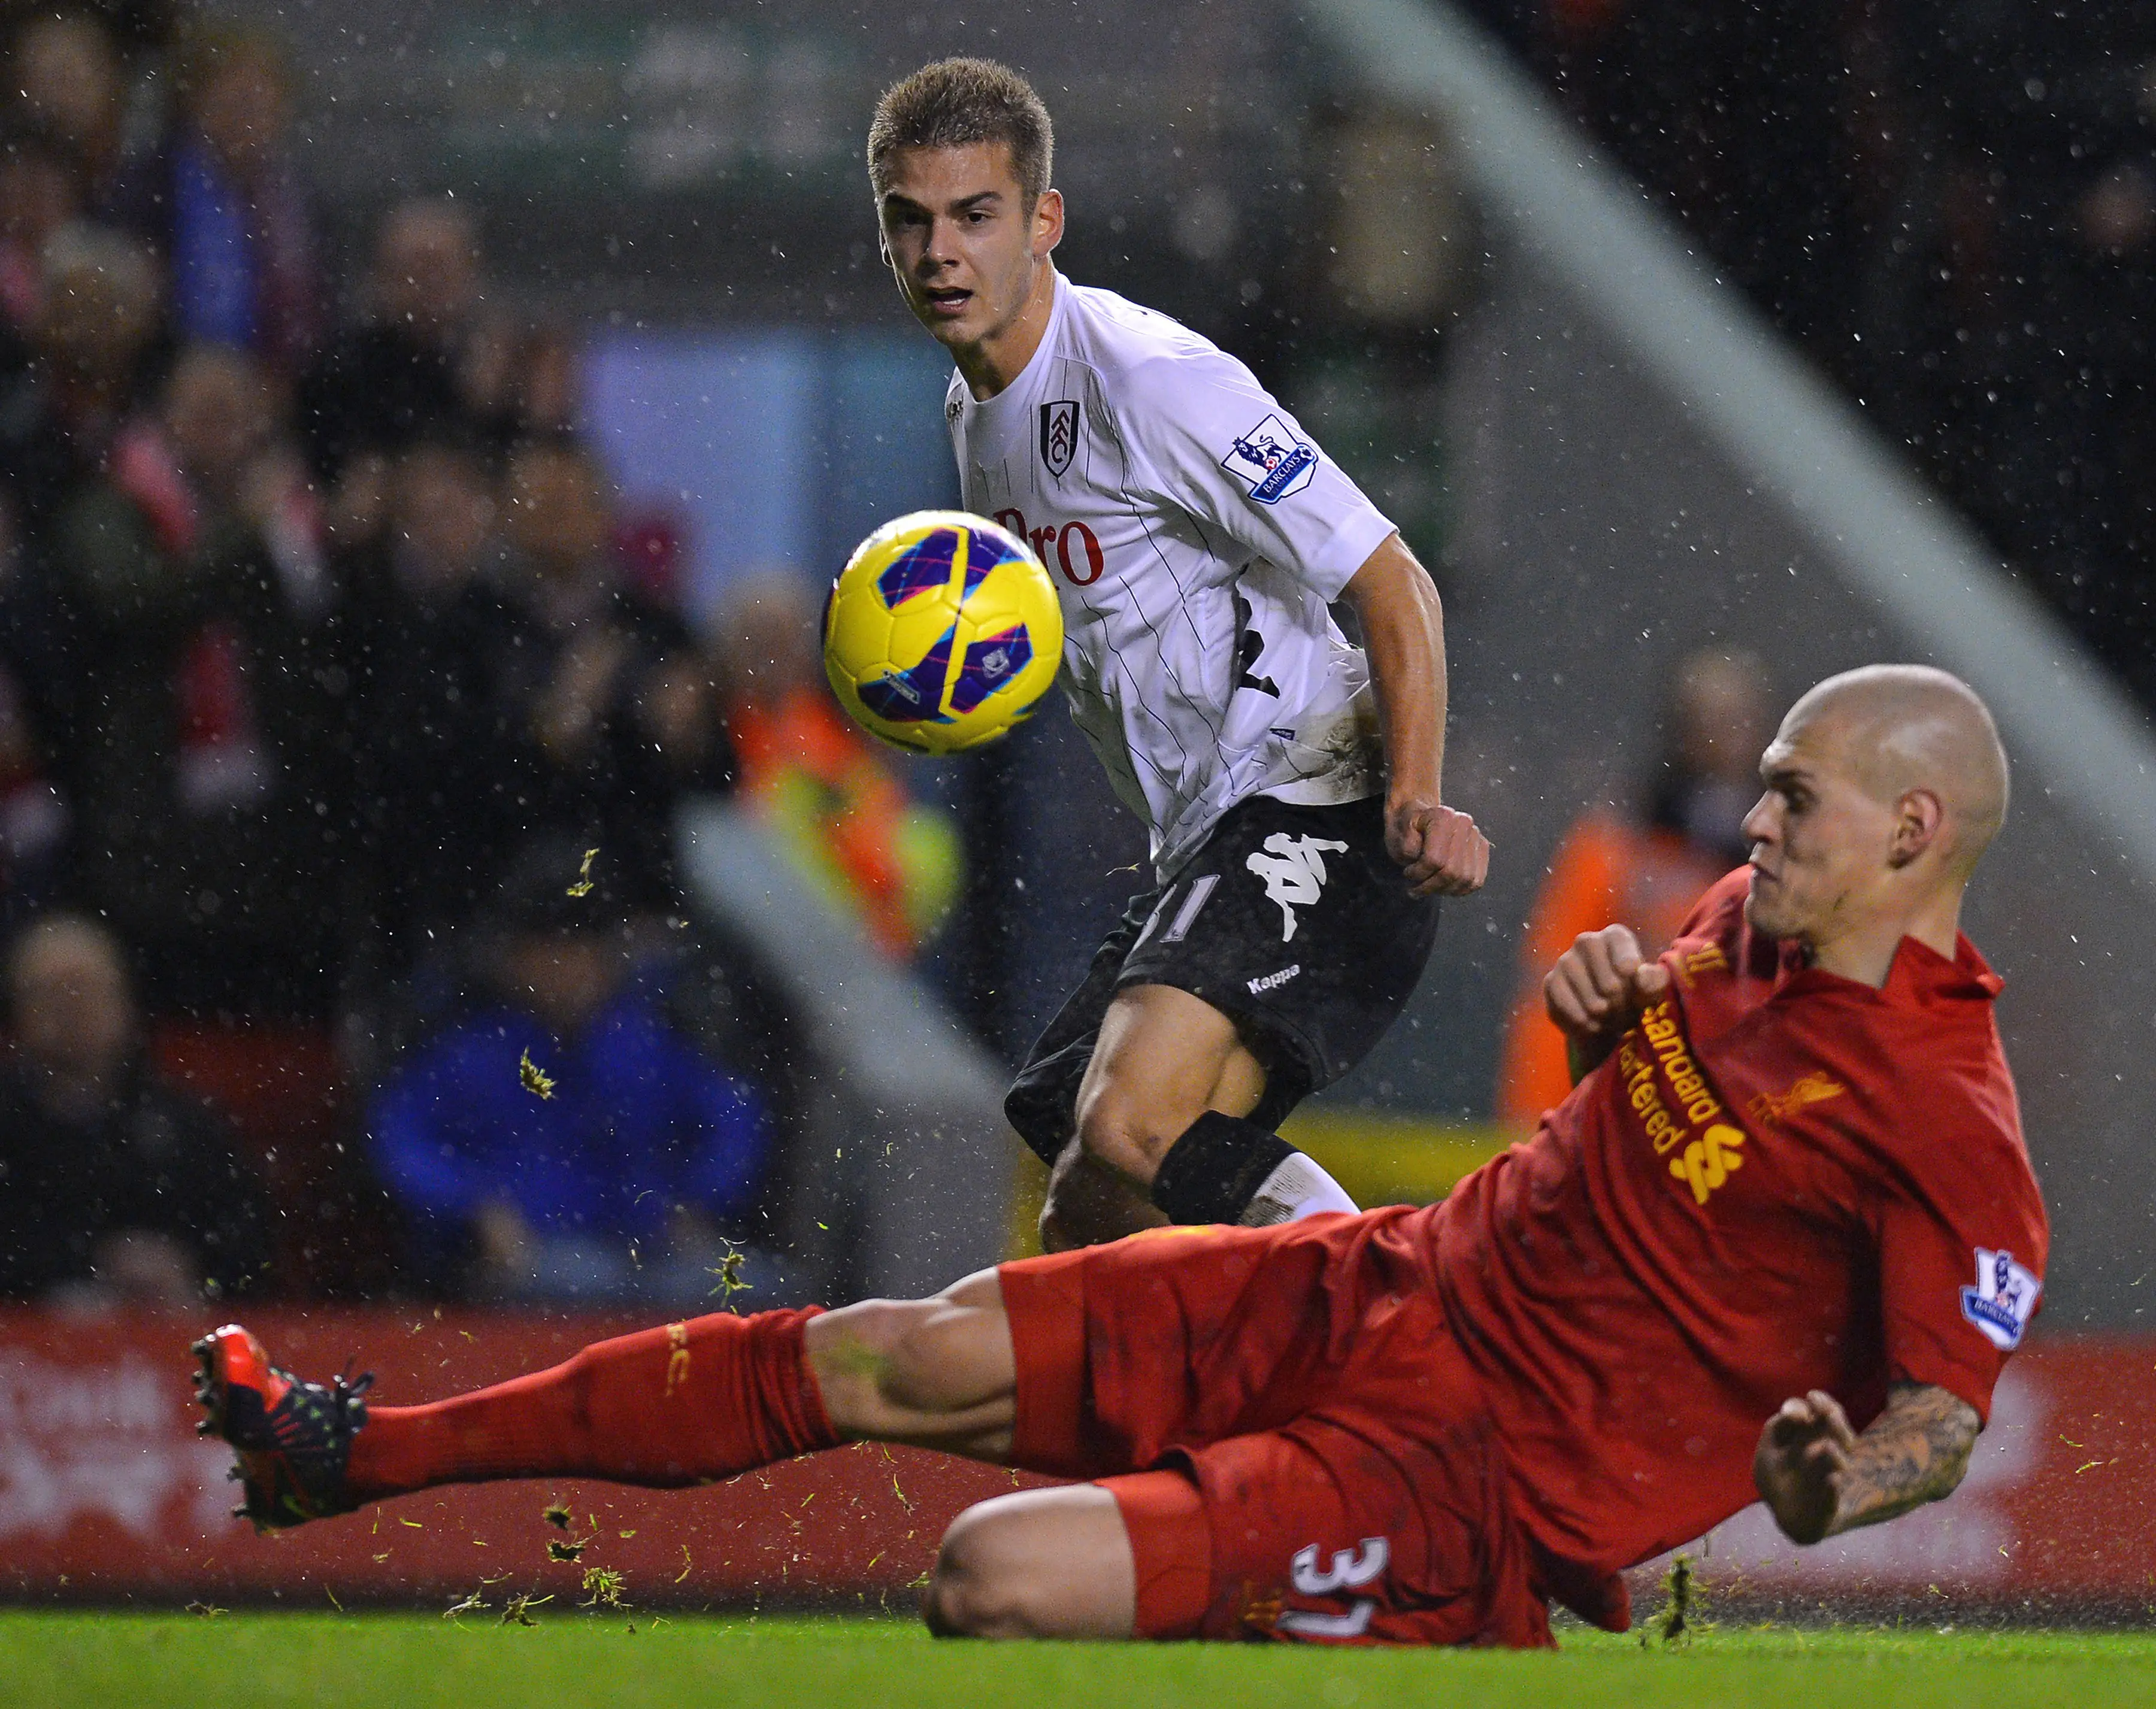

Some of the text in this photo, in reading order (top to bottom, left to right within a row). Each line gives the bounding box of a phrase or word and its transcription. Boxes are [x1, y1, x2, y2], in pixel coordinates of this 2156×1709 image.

[1262, 454, 1301, 493] BARCLAYS
[1246, 963, 1301, 995] Kappa
[1619, 1028, 1688, 1155] artered
[1641, 1001, 1721, 1125] tandard
